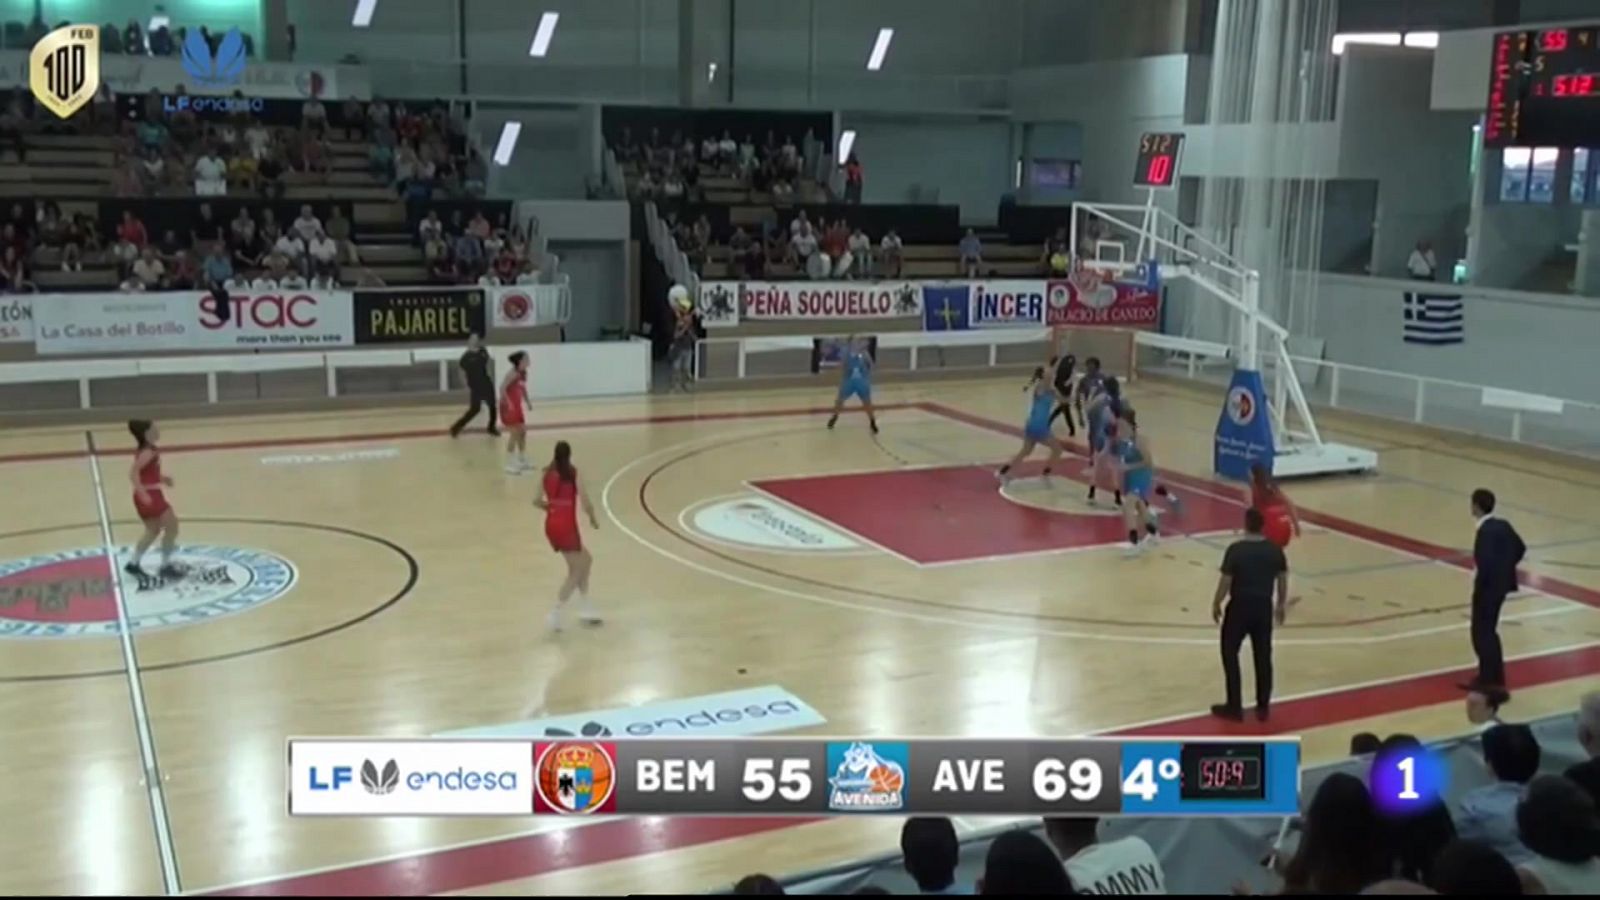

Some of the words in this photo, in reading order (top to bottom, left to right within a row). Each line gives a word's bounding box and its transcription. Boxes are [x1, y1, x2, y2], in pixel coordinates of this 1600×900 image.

[1147, 155, 1170, 183] 10
[745, 286, 792, 315] PEÑA
[797, 290, 891, 315] SOCUELLO
[41, 326, 60, 339] La
[63, 323, 103, 338] Casa
[107, 322, 132, 336] del
[136, 320, 186, 335] Botillo
[371, 307, 471, 335] PAJARIEL
[236, 334, 268, 343] more
[270, 333, 298, 343] than
[300, 333, 320, 344] you
[625, 698, 800, 736] endesa
